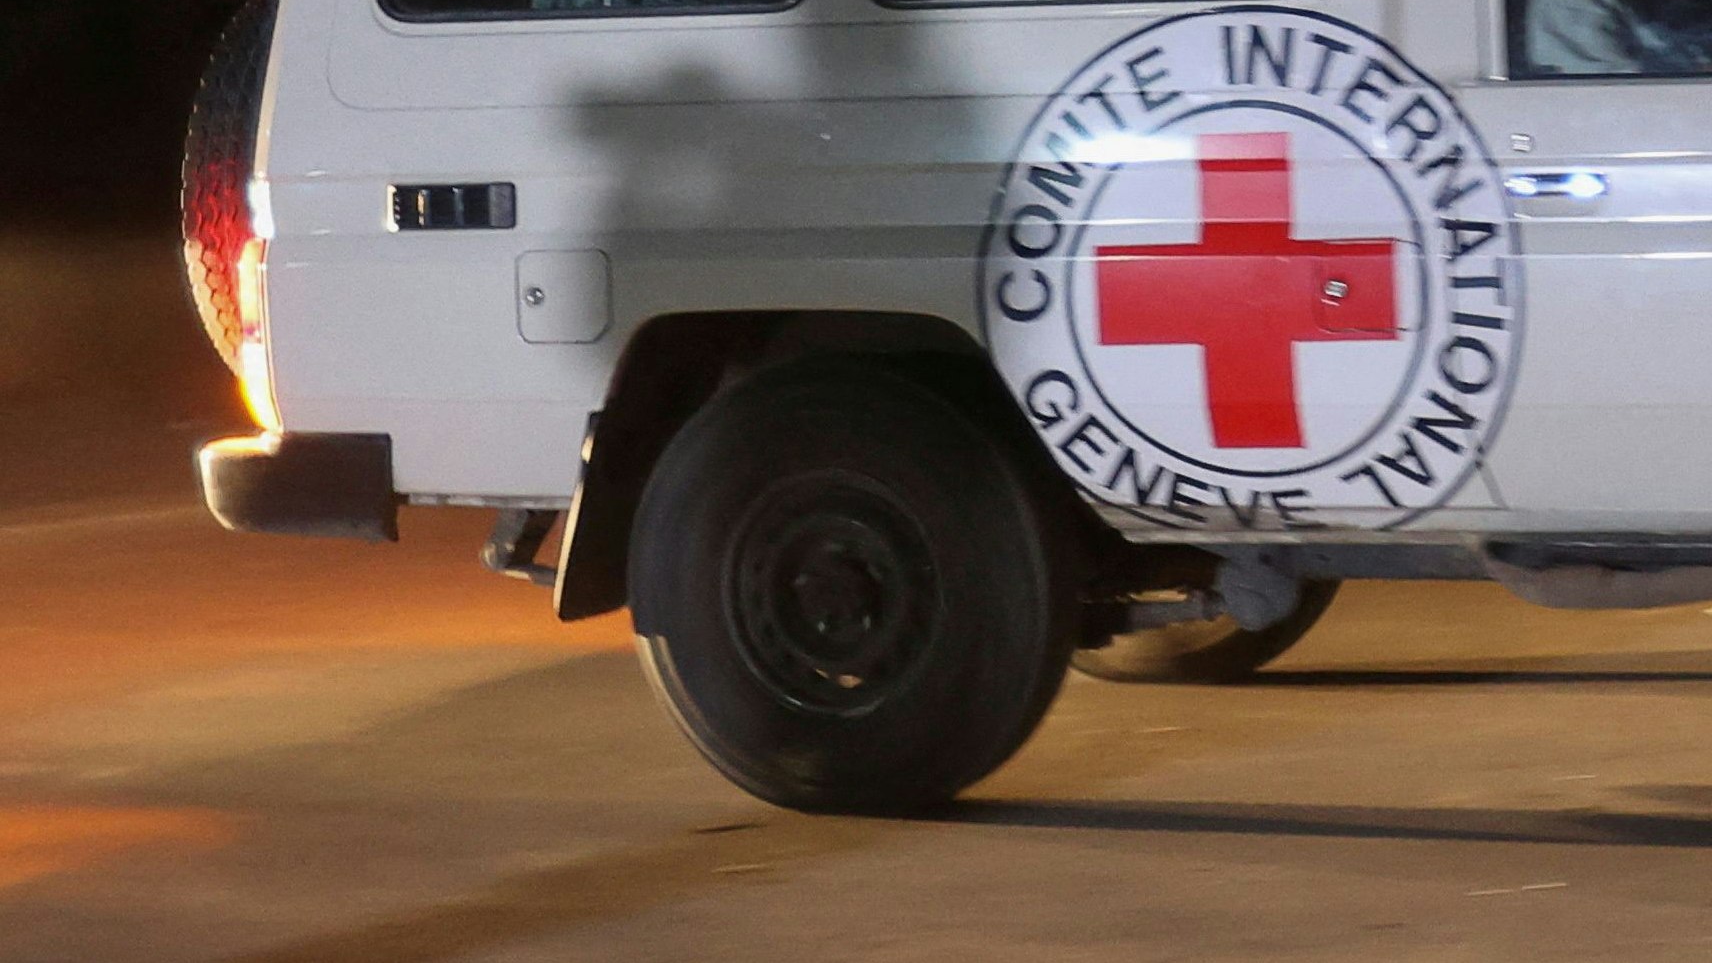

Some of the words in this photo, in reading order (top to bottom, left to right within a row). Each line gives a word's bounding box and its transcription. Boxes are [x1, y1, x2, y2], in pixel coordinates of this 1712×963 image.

[998, 46, 1183, 323] COMITE
[1220, 24, 1511, 510] INTERNATIONAL
[1024, 368, 1316, 531] GENEVE
